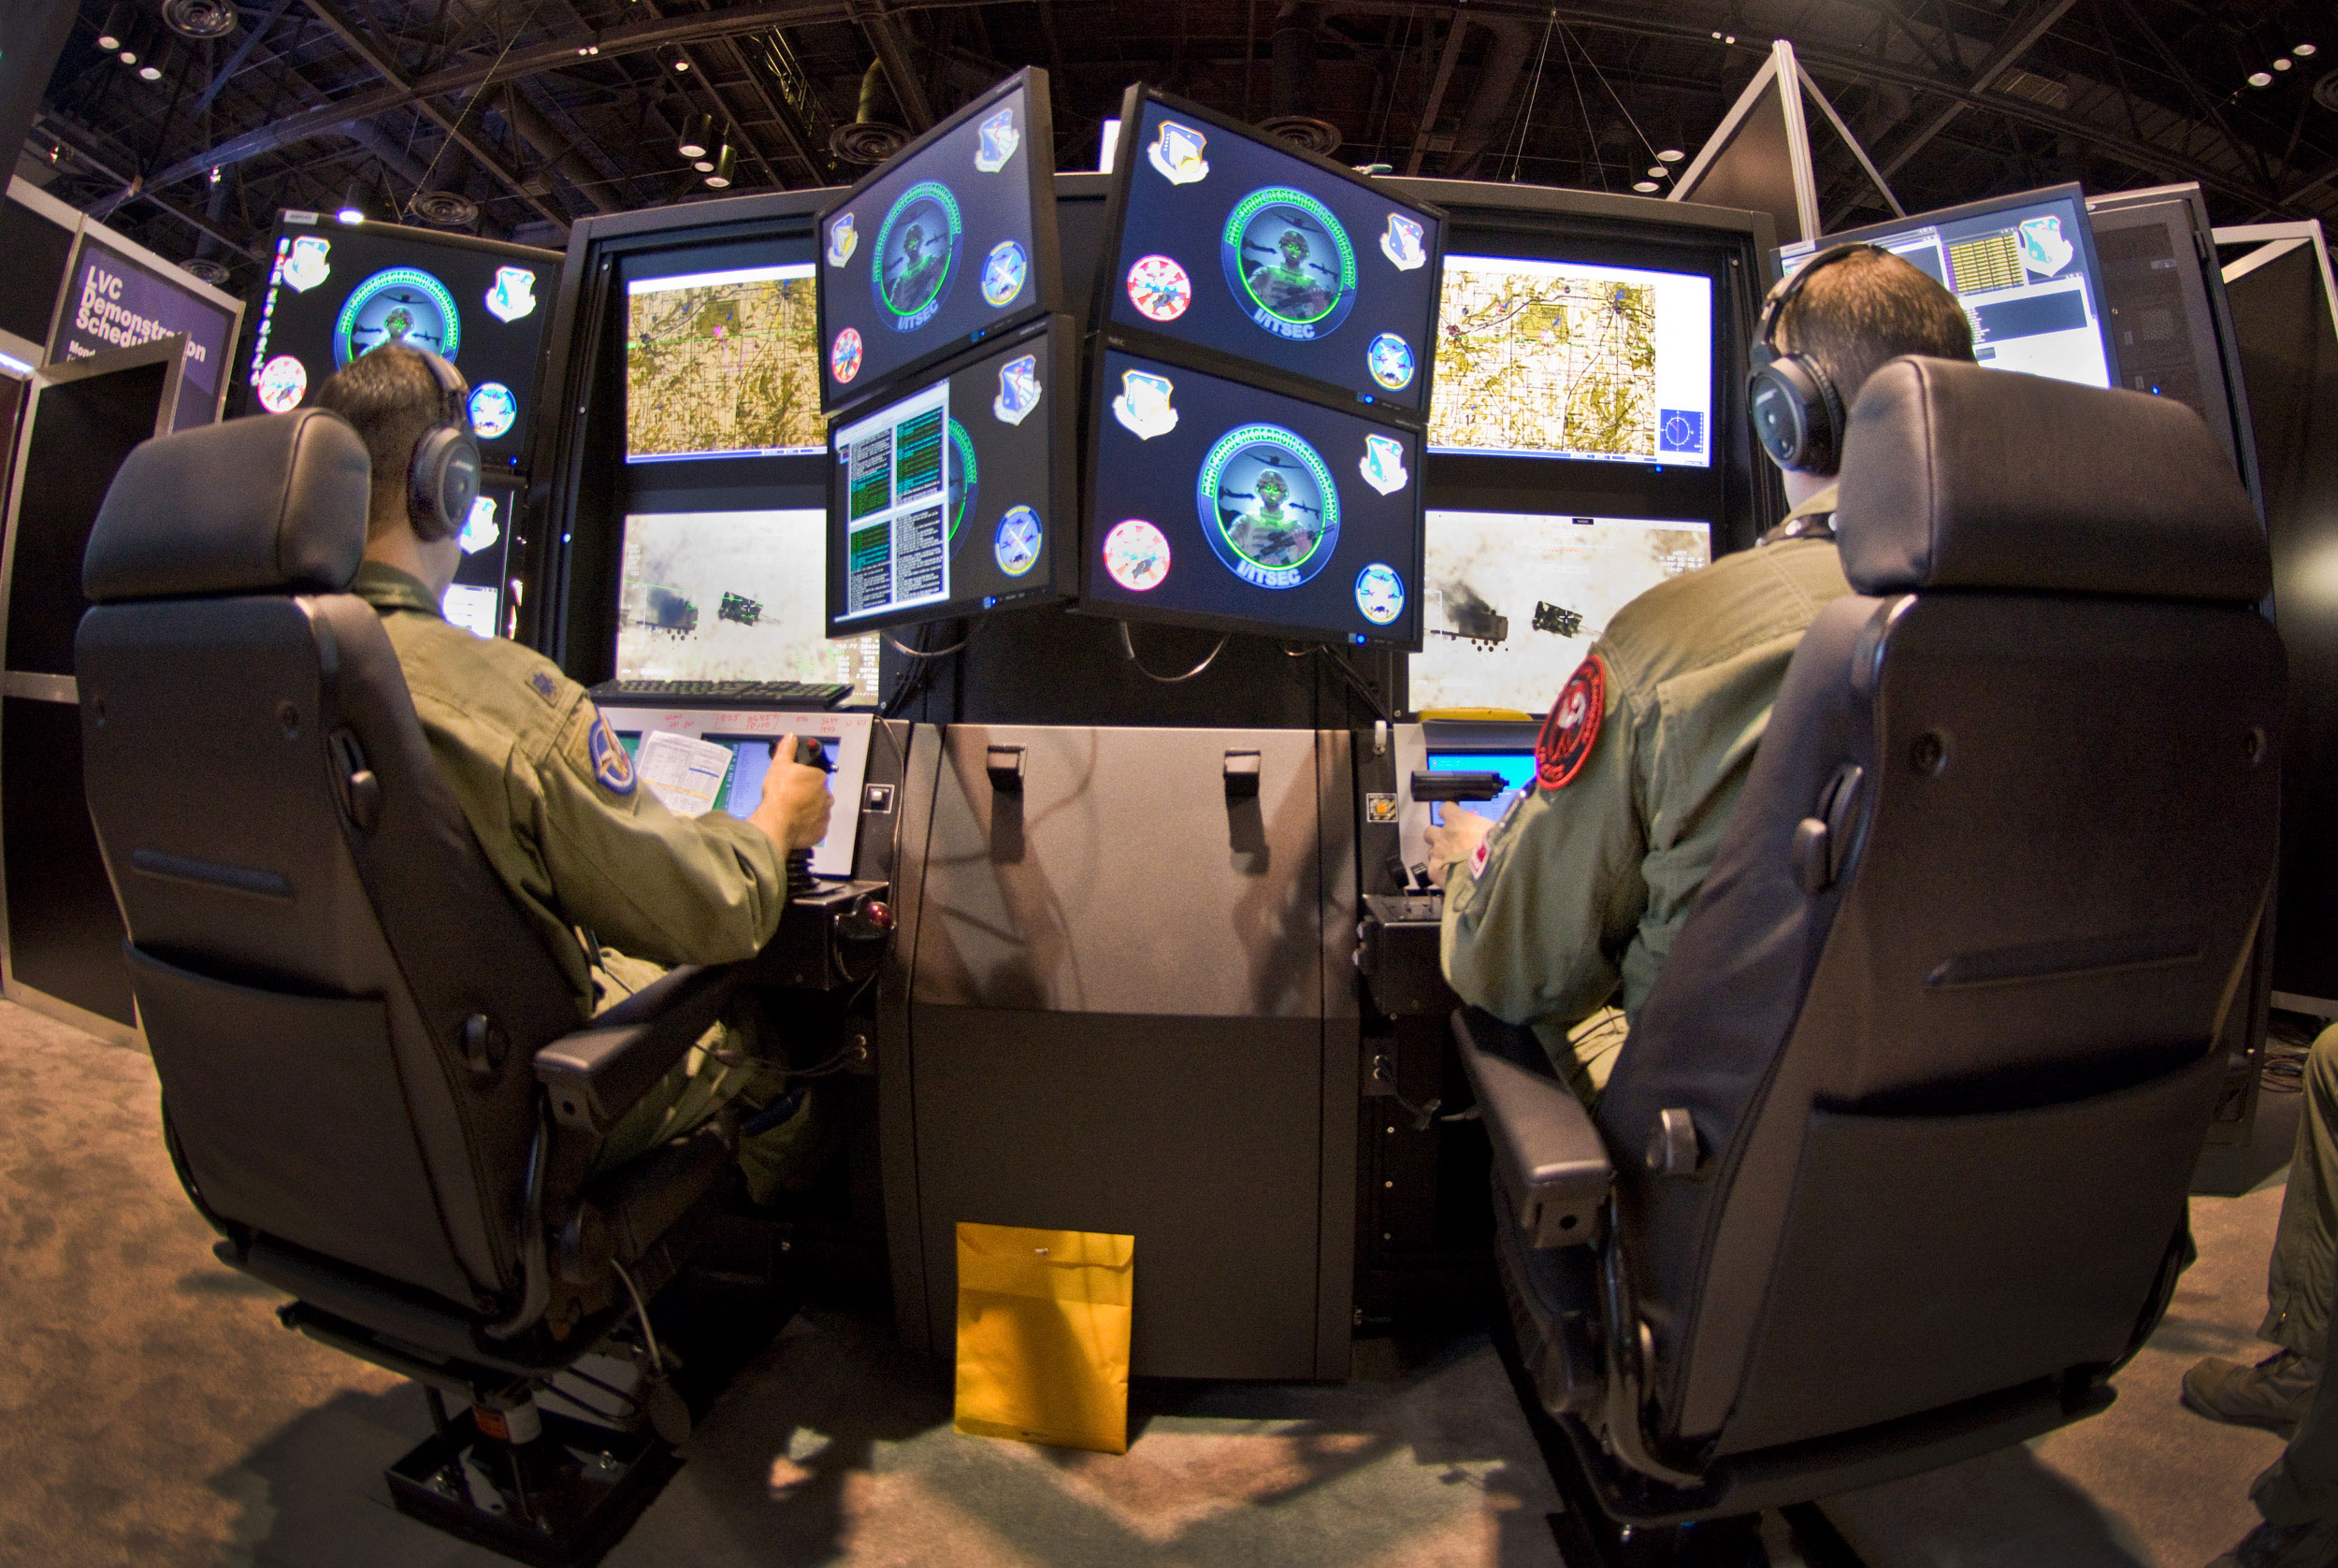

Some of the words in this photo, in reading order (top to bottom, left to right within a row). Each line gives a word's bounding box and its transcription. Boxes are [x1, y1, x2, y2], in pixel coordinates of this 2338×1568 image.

[1225, 218, 1243, 248] AIR
[1236, 193, 1266, 222] FORCE
[1266, 189, 1321, 215] RESEARCH
[1319, 209, 1356, 290] LABORATORY
[86, 265, 123, 300] LVC
[80, 285, 207, 363] Demonstron
[1209, 435, 1241, 470] FORCE
[1239, 426, 1297, 447] RESEARCH
[1201, 467, 1219, 498] AIR
[1295, 442, 1338, 524] LABORATORY
